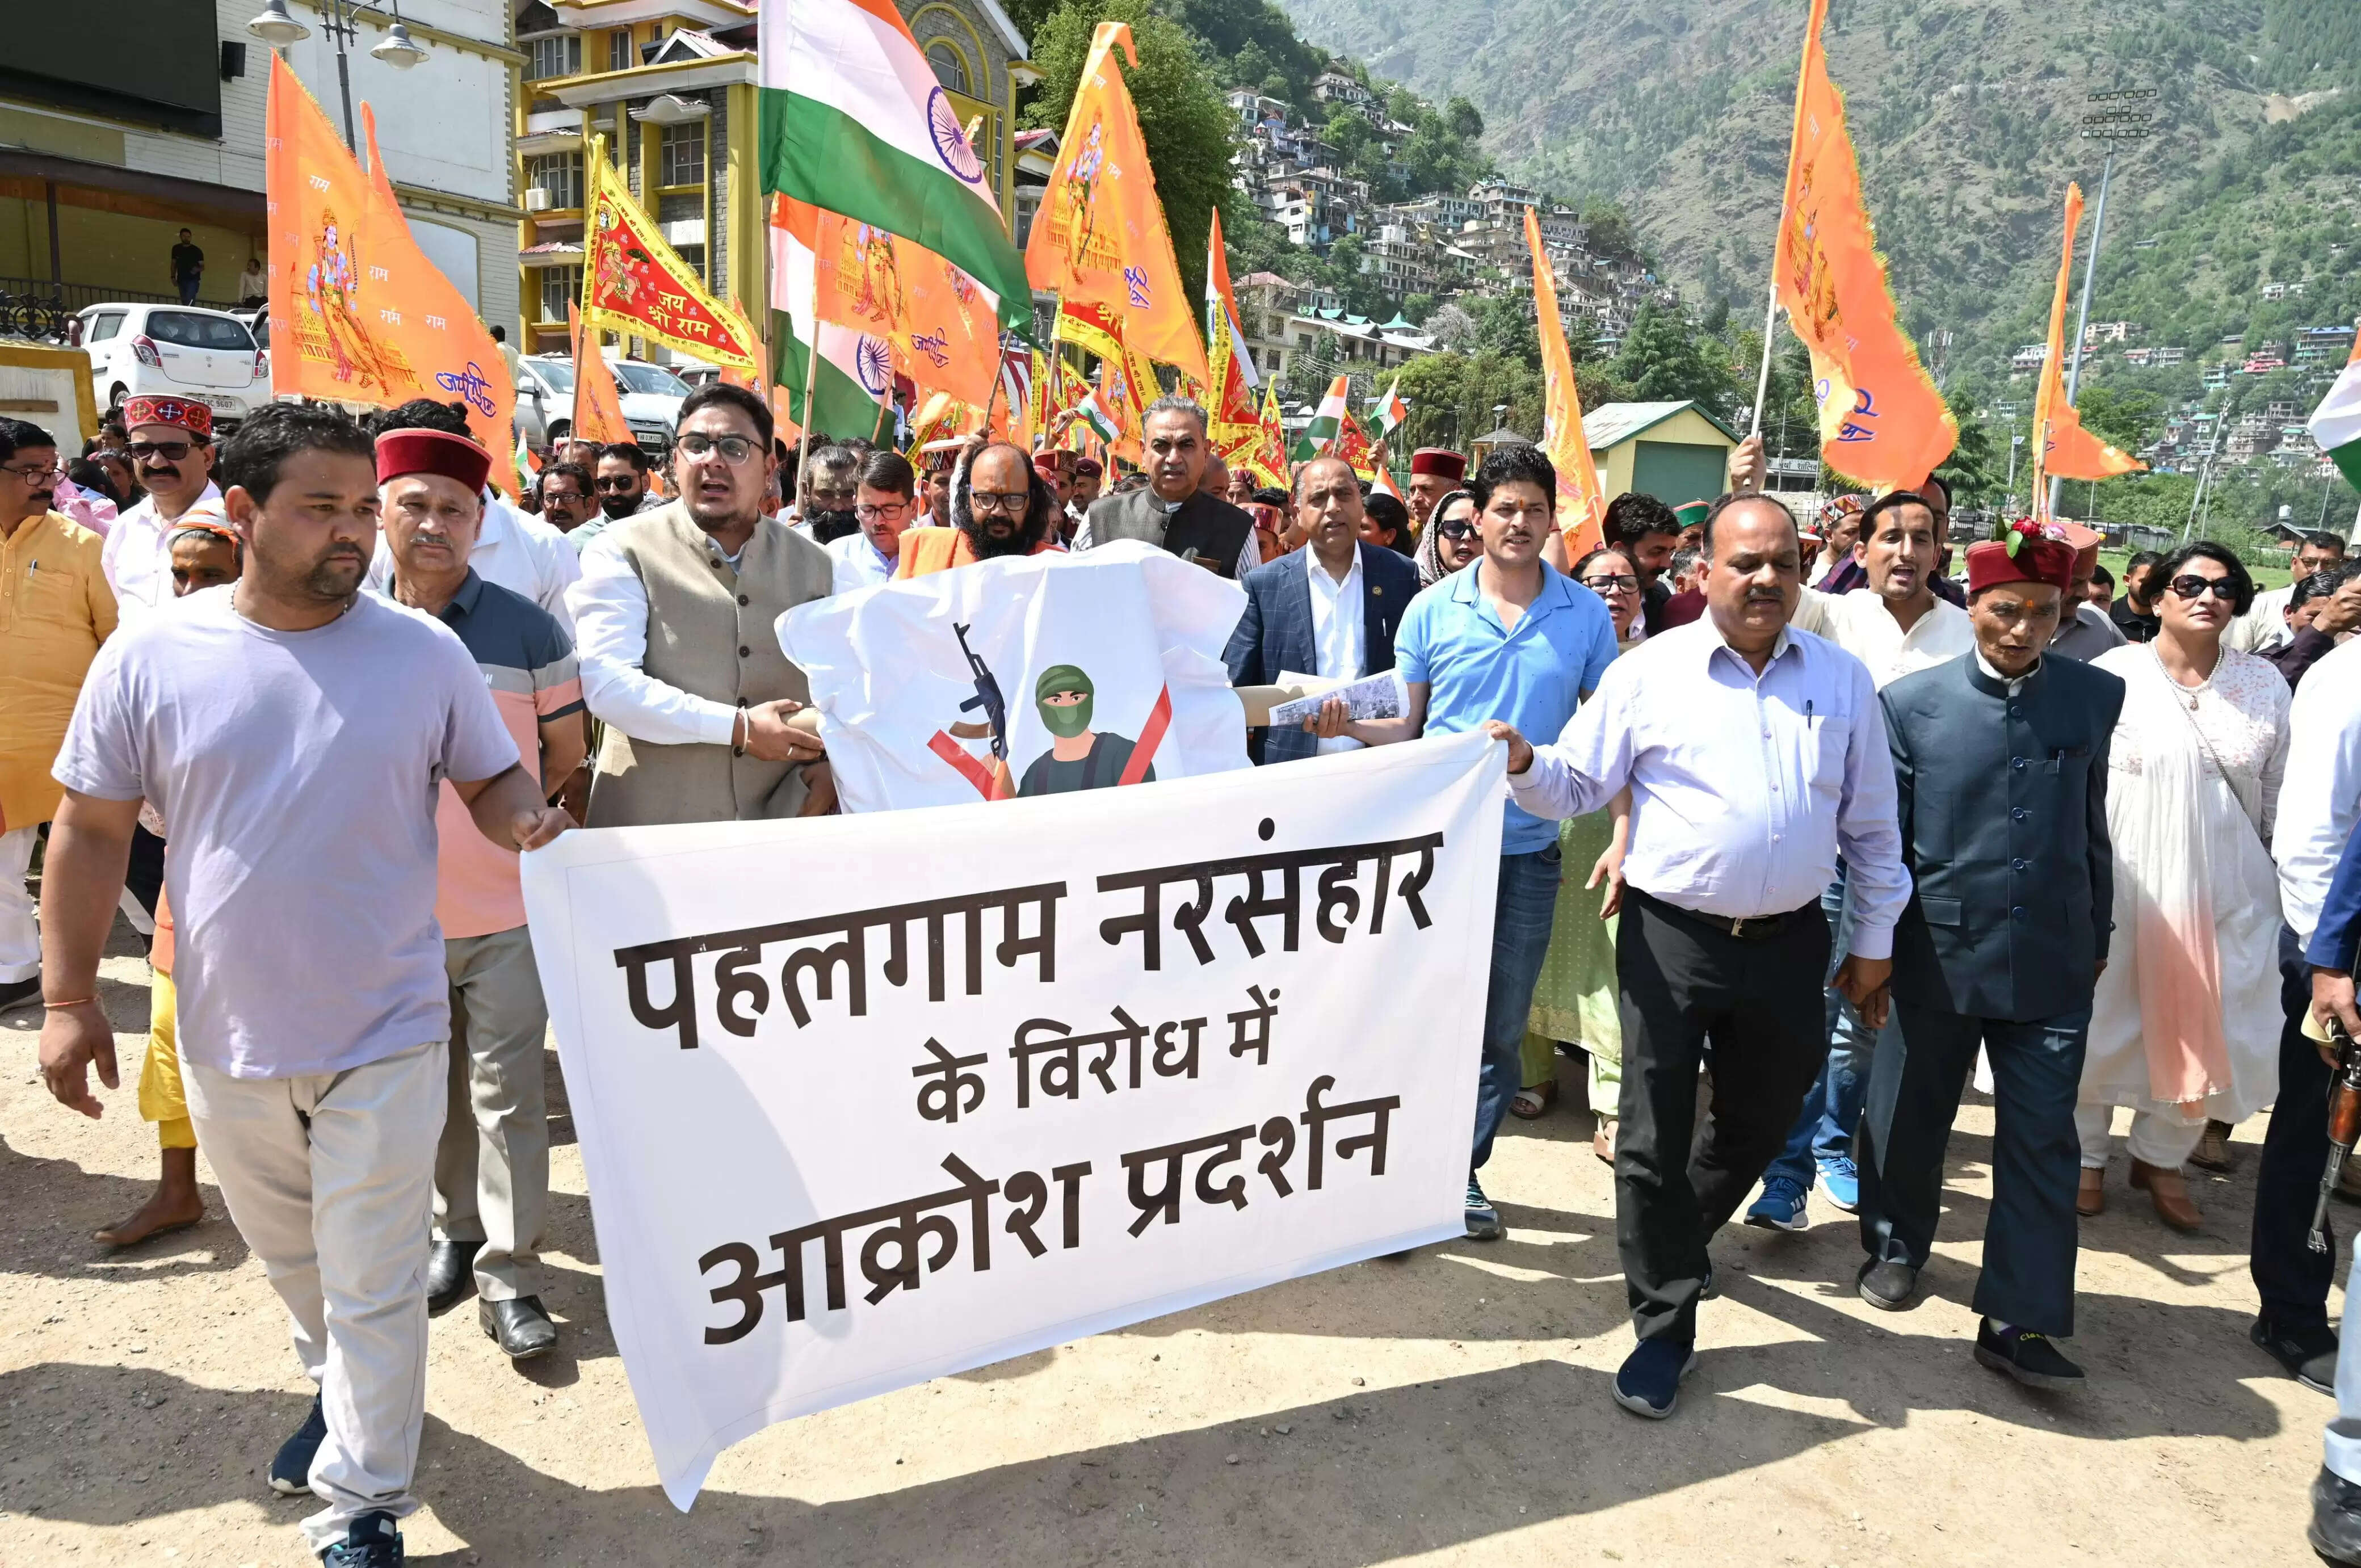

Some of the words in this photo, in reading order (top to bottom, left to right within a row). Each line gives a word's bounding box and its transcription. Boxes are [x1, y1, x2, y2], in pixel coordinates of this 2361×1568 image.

[1107, 161, 1122, 179] राम
[309, 175, 331, 193] राम
[369, 265, 390, 281] राम
[658, 290, 687, 314] जय
[381, 309, 402, 325] राम
[426, 314, 447, 330] राम
[648, 305, 672, 330] श्री
[677, 317, 712, 339] राम
[216, 400, 233, 409] 9607
[1349, 456, 1362, 466] श्री
[614, 881, 1067, 1050] पहलगाम
[1097, 817, 1443, 971] नरसंहार
[912, 1037, 988, 1123] के
[1009, 1005, 1208, 1108] विरोध
[1228, 984, 1280, 1065] में
[698, 1152, 1093, 1345] आक्रोश
[1121, 1075, 1400, 1238] प्रदर्शन
